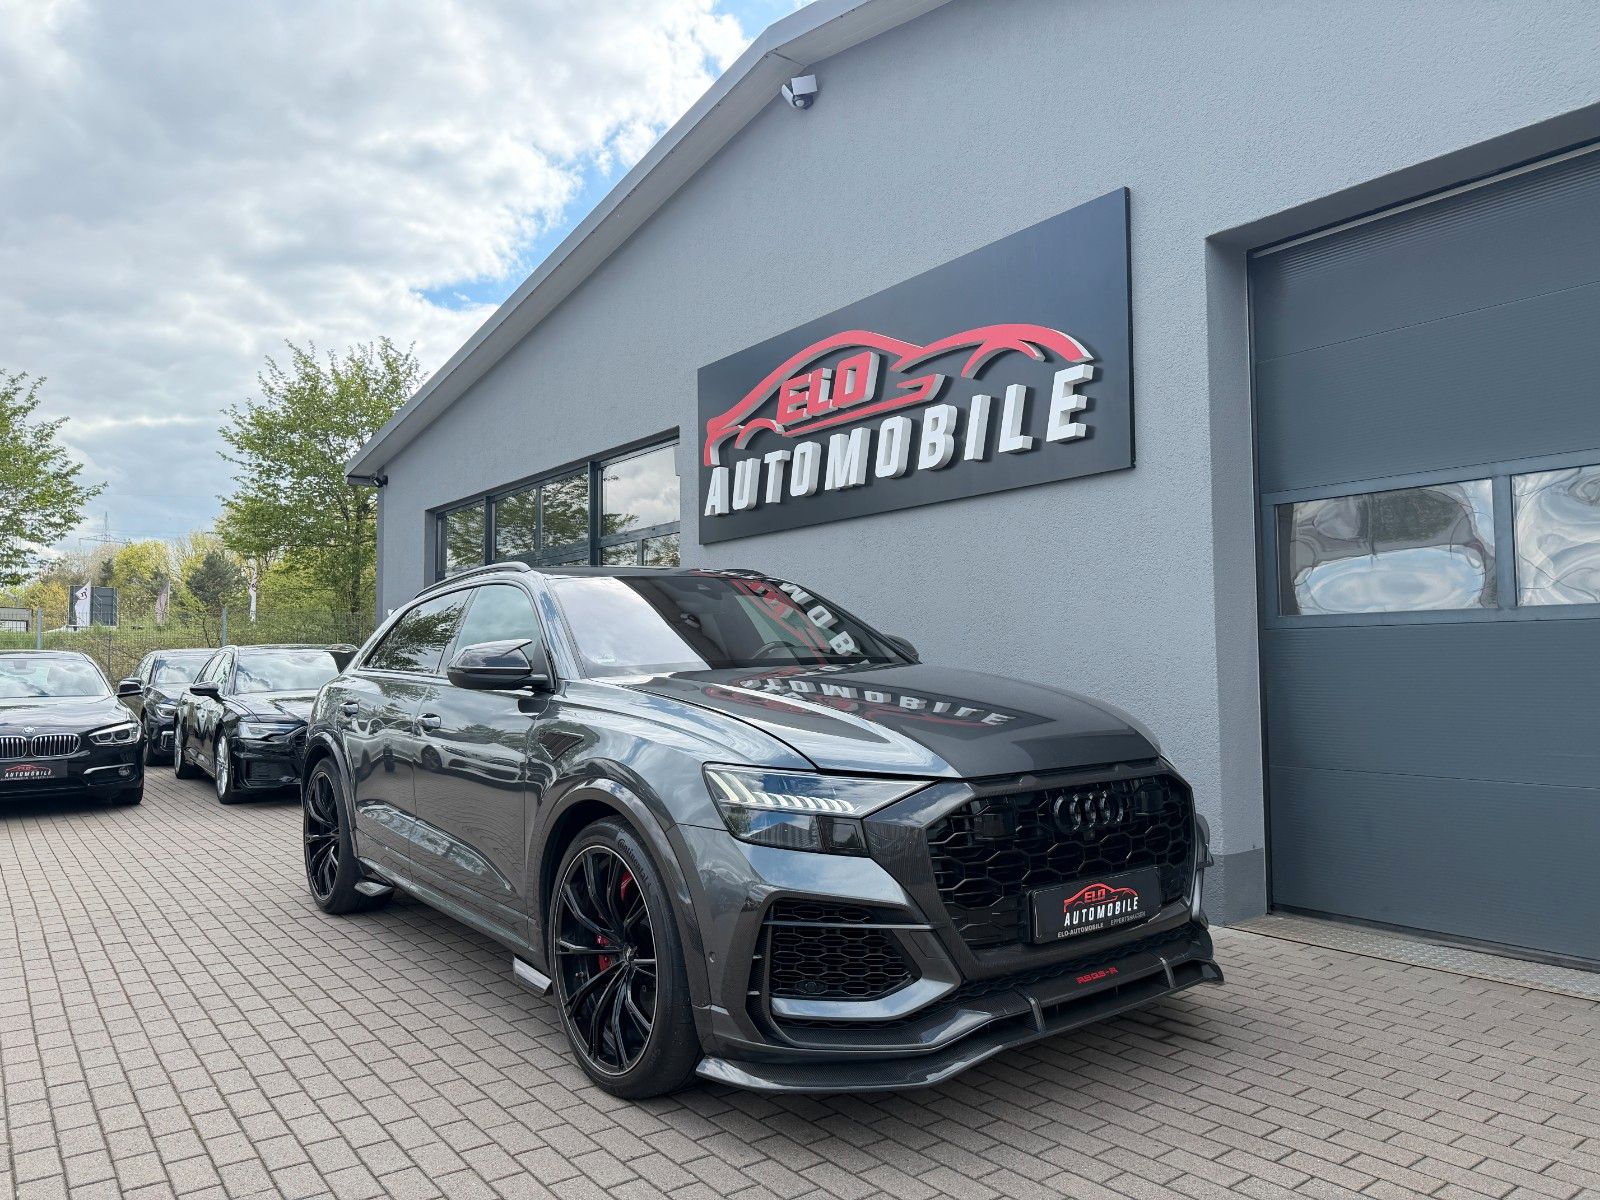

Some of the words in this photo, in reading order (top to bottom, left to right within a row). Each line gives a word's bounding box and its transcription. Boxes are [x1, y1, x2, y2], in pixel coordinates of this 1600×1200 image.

[776, 351, 880, 425] ELO
[704, 364, 1094, 517] AUTOMOBILE
[4, 770, 52, 778] AUTOMOBILE
[617, 838, 649, 882] Continental
[1084, 888, 1107, 903] ELO
[1064, 896, 1139, 927] AUTOMOBILE
[1057, 922, 1104, 938] ELO-AUTOMOBILE
